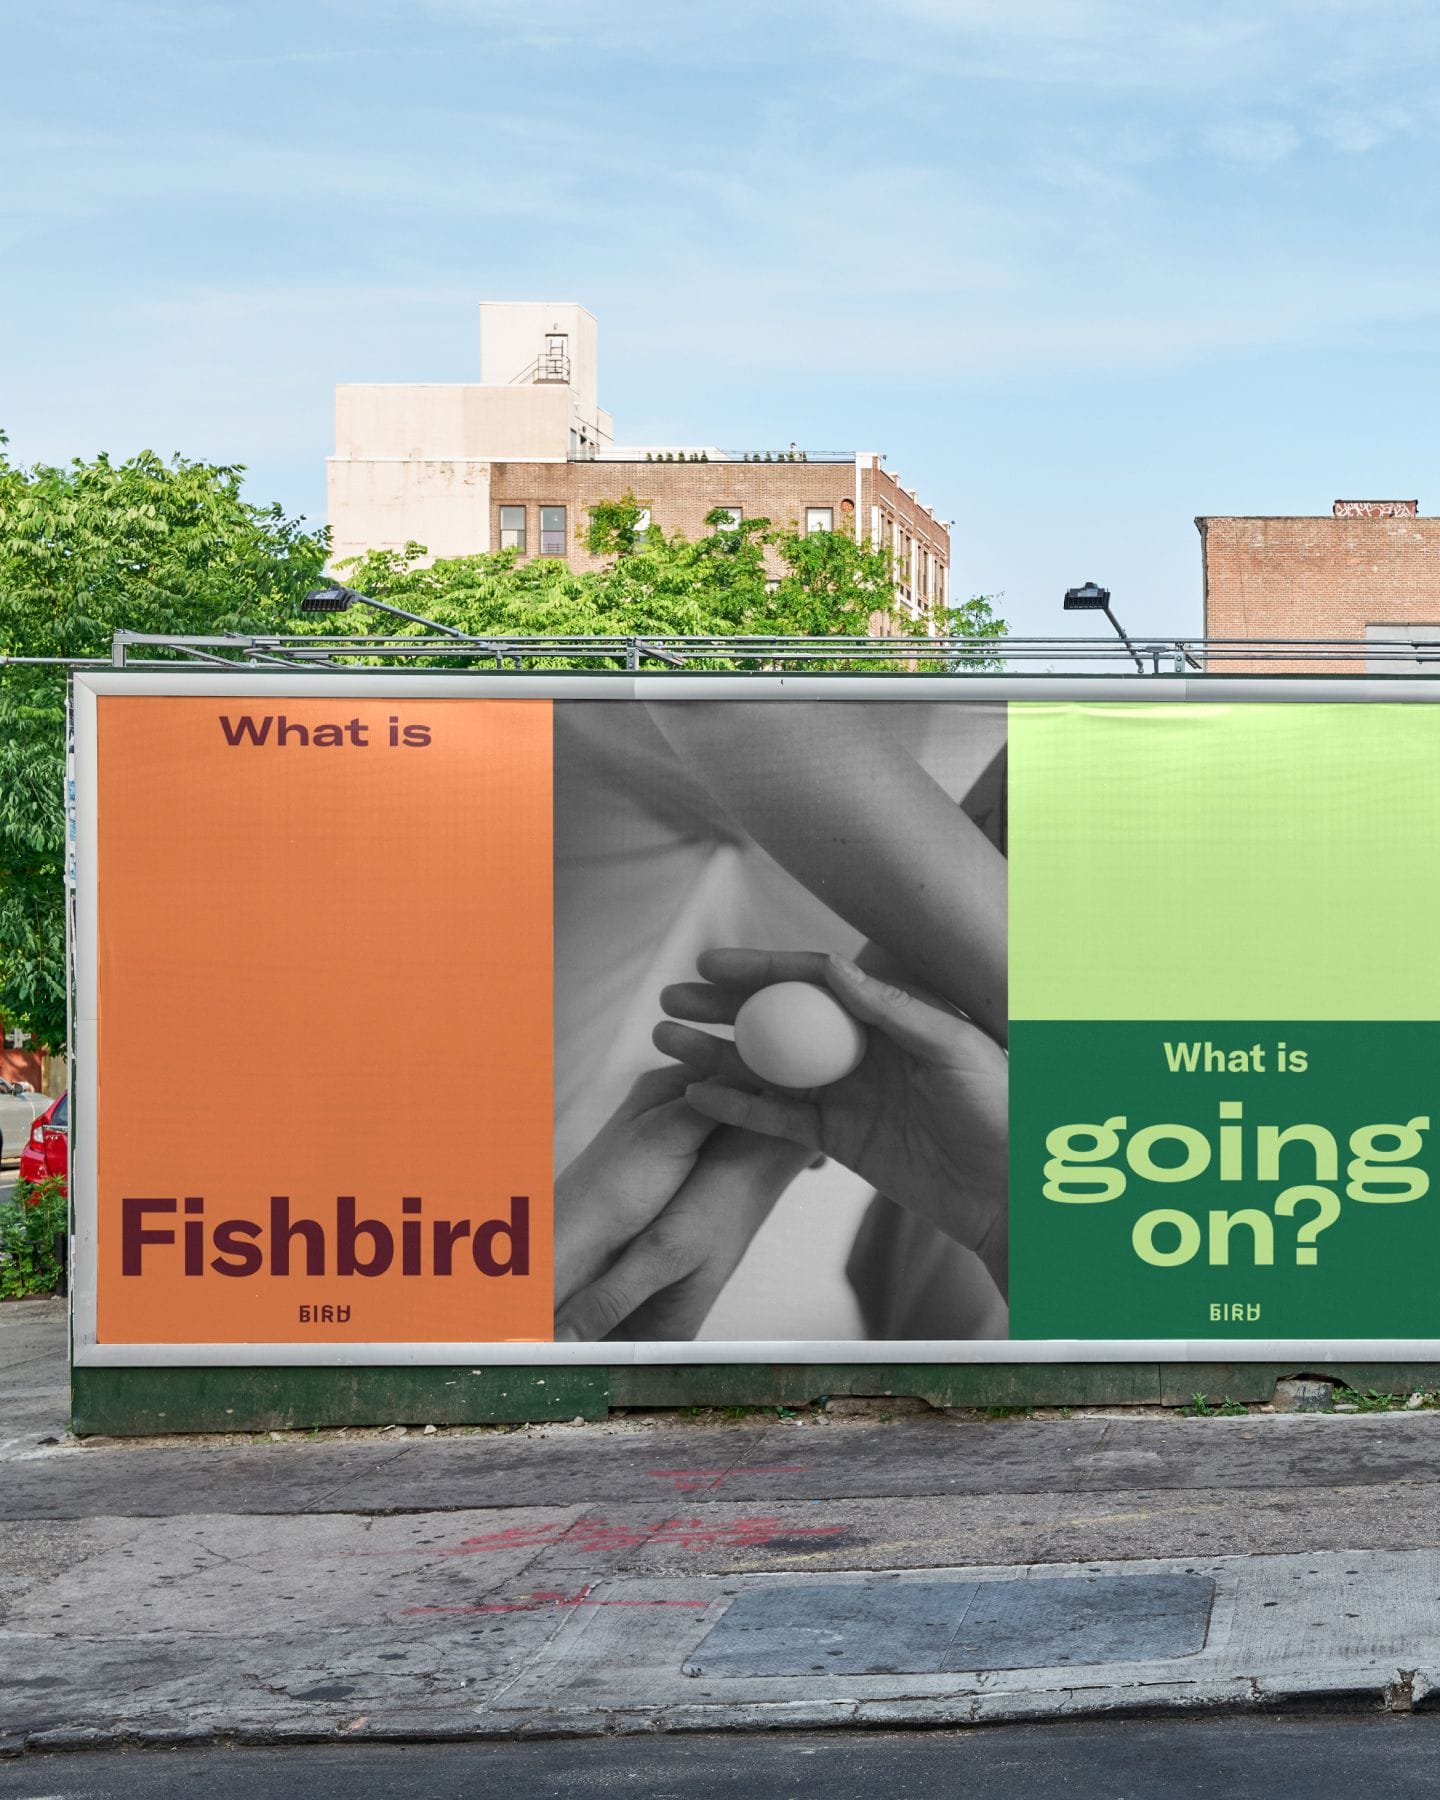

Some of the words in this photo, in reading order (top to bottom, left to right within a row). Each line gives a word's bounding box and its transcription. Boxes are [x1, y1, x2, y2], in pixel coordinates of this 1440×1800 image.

[219, 716, 368, 747] What
[390, 716, 431, 747] is
[1164, 1042, 1265, 1073] What
[1278, 1042, 1308, 1073] is
[1043, 1102, 1429, 1204] going
[122, 1197, 529, 1277] Fishbird
[1132, 1185, 1341, 1267] on?
